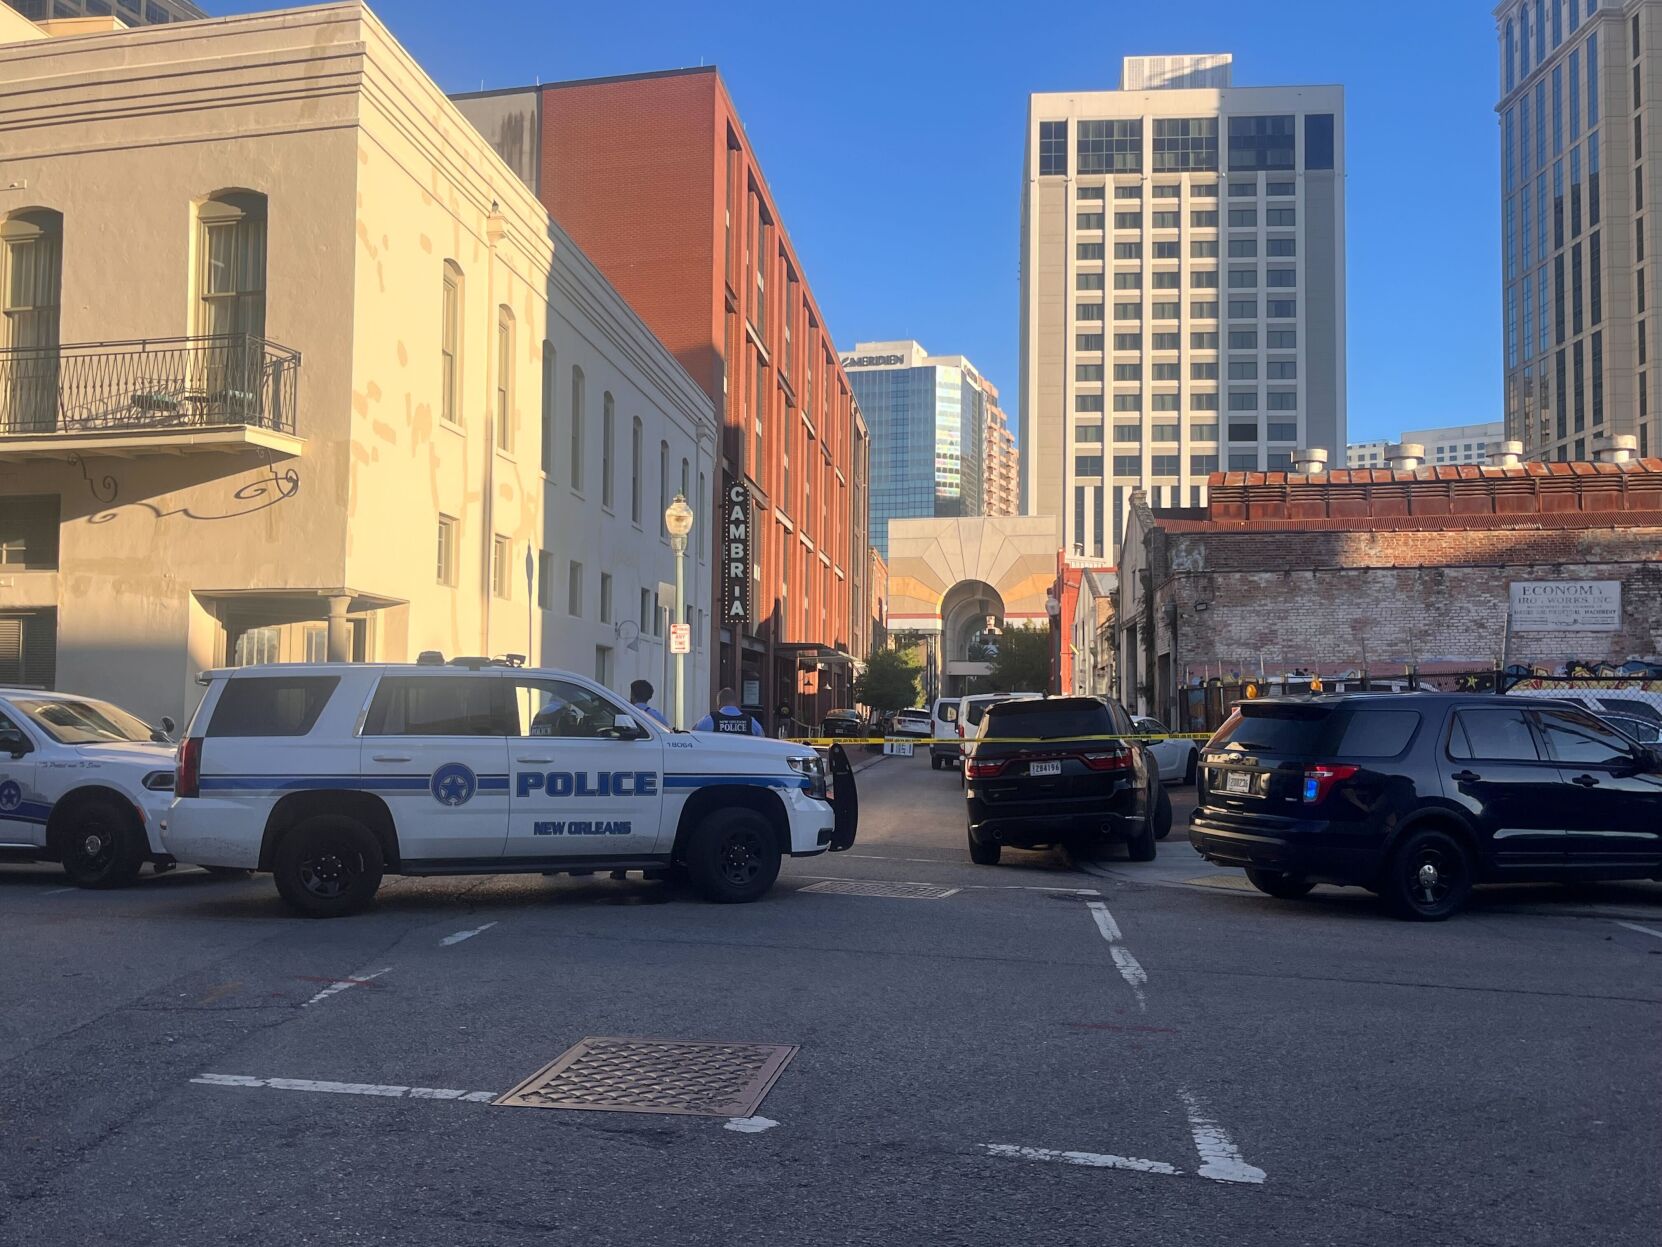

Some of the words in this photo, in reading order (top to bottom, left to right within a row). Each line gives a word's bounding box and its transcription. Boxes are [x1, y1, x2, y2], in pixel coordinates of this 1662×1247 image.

[730, 487, 746, 616] CAMBRIA
[1548, 596, 1588, 604] WORKS
[719, 723, 747, 732] POLICE
[516, 771, 658, 798] POLICE
[533, 821, 565, 836] NEW
[568, 821, 632, 836] ORLEANS
